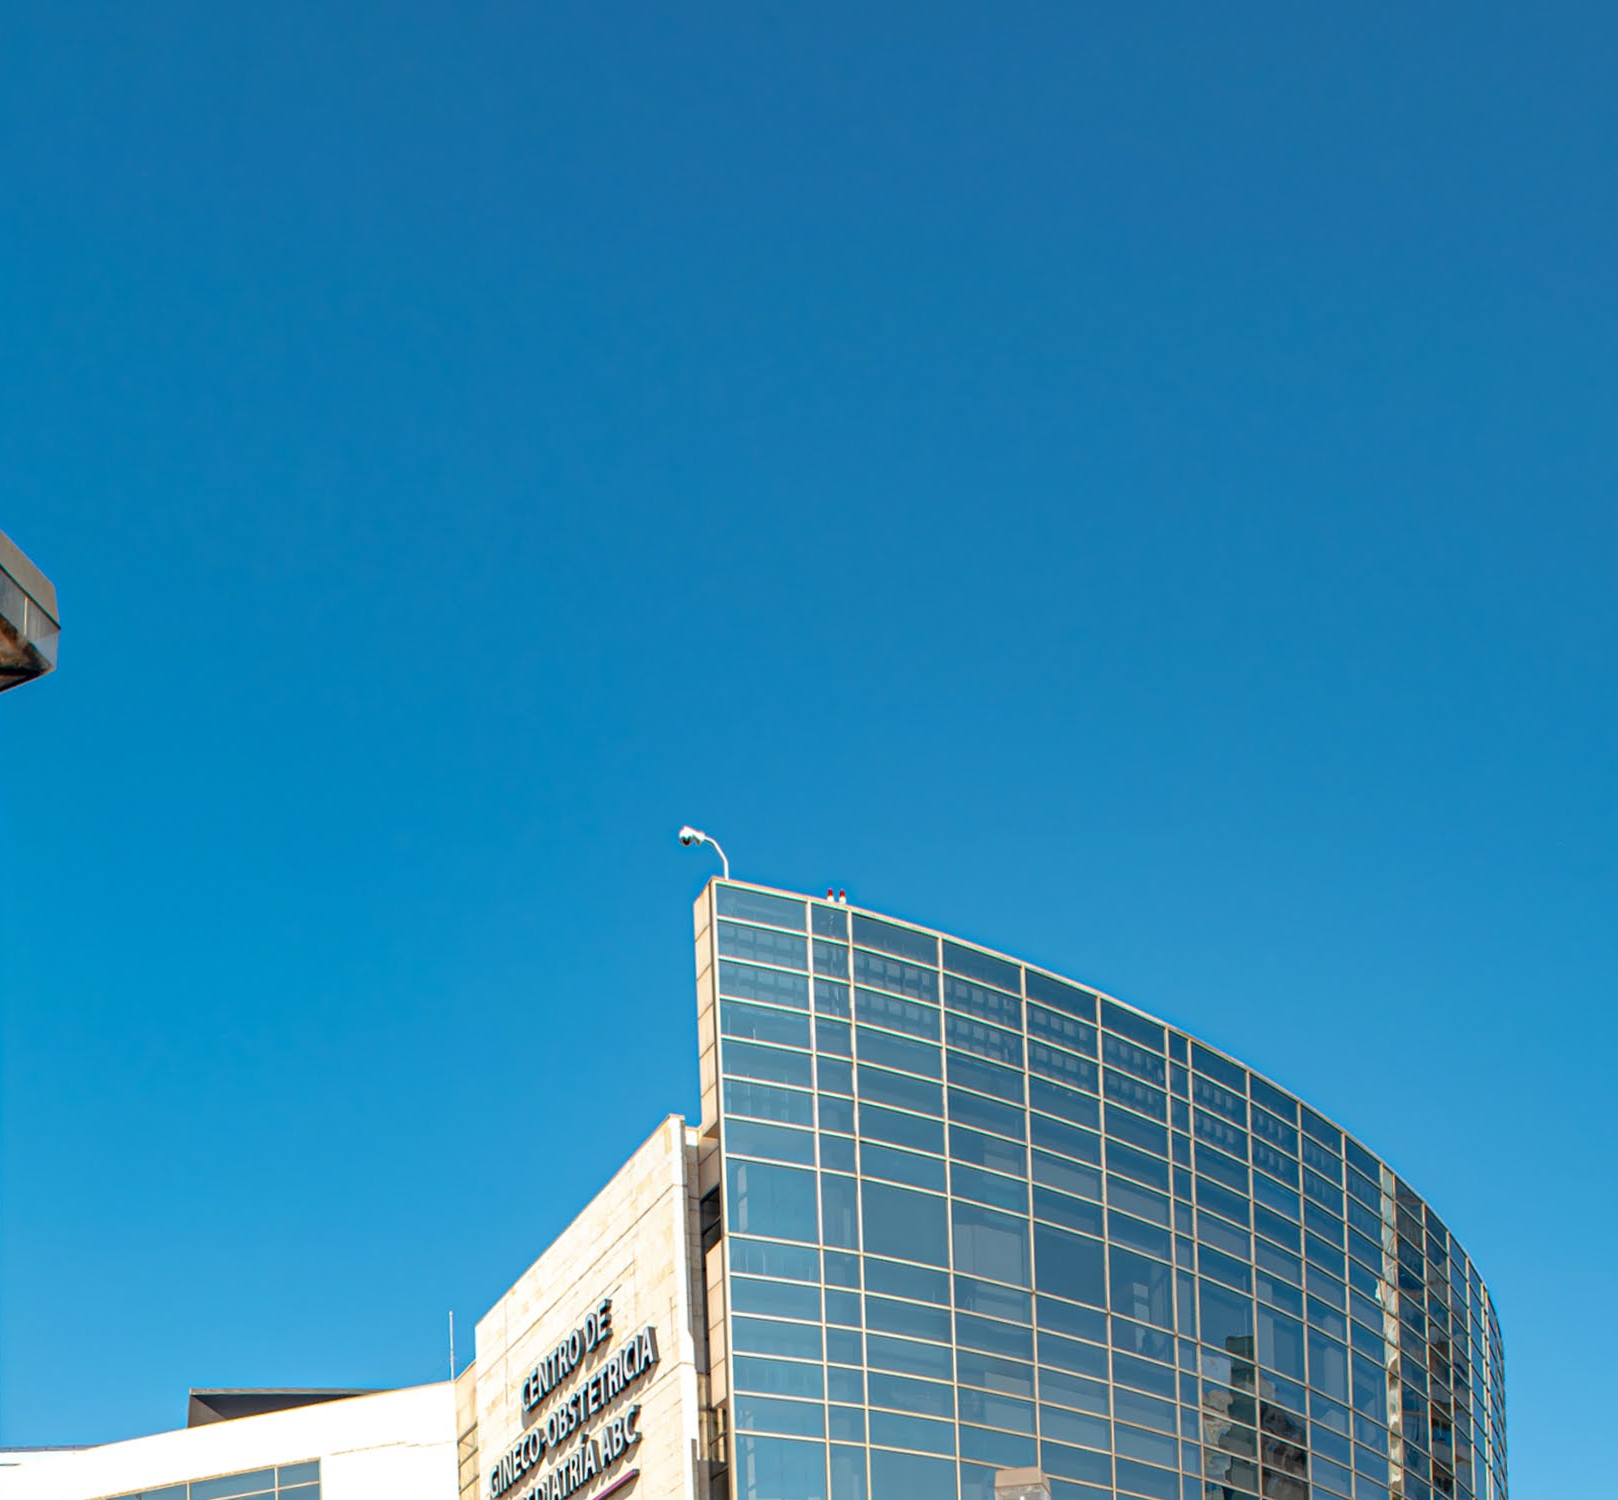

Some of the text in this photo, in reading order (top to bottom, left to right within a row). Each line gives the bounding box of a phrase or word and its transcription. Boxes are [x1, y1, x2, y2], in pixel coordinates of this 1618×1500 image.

[490, 1326, 660, 1499] GINECO-OBSTETRICIA
[521, 1299, 613, 1413] CENTRO DE
[601, 1404, 642, 1469] ABC
